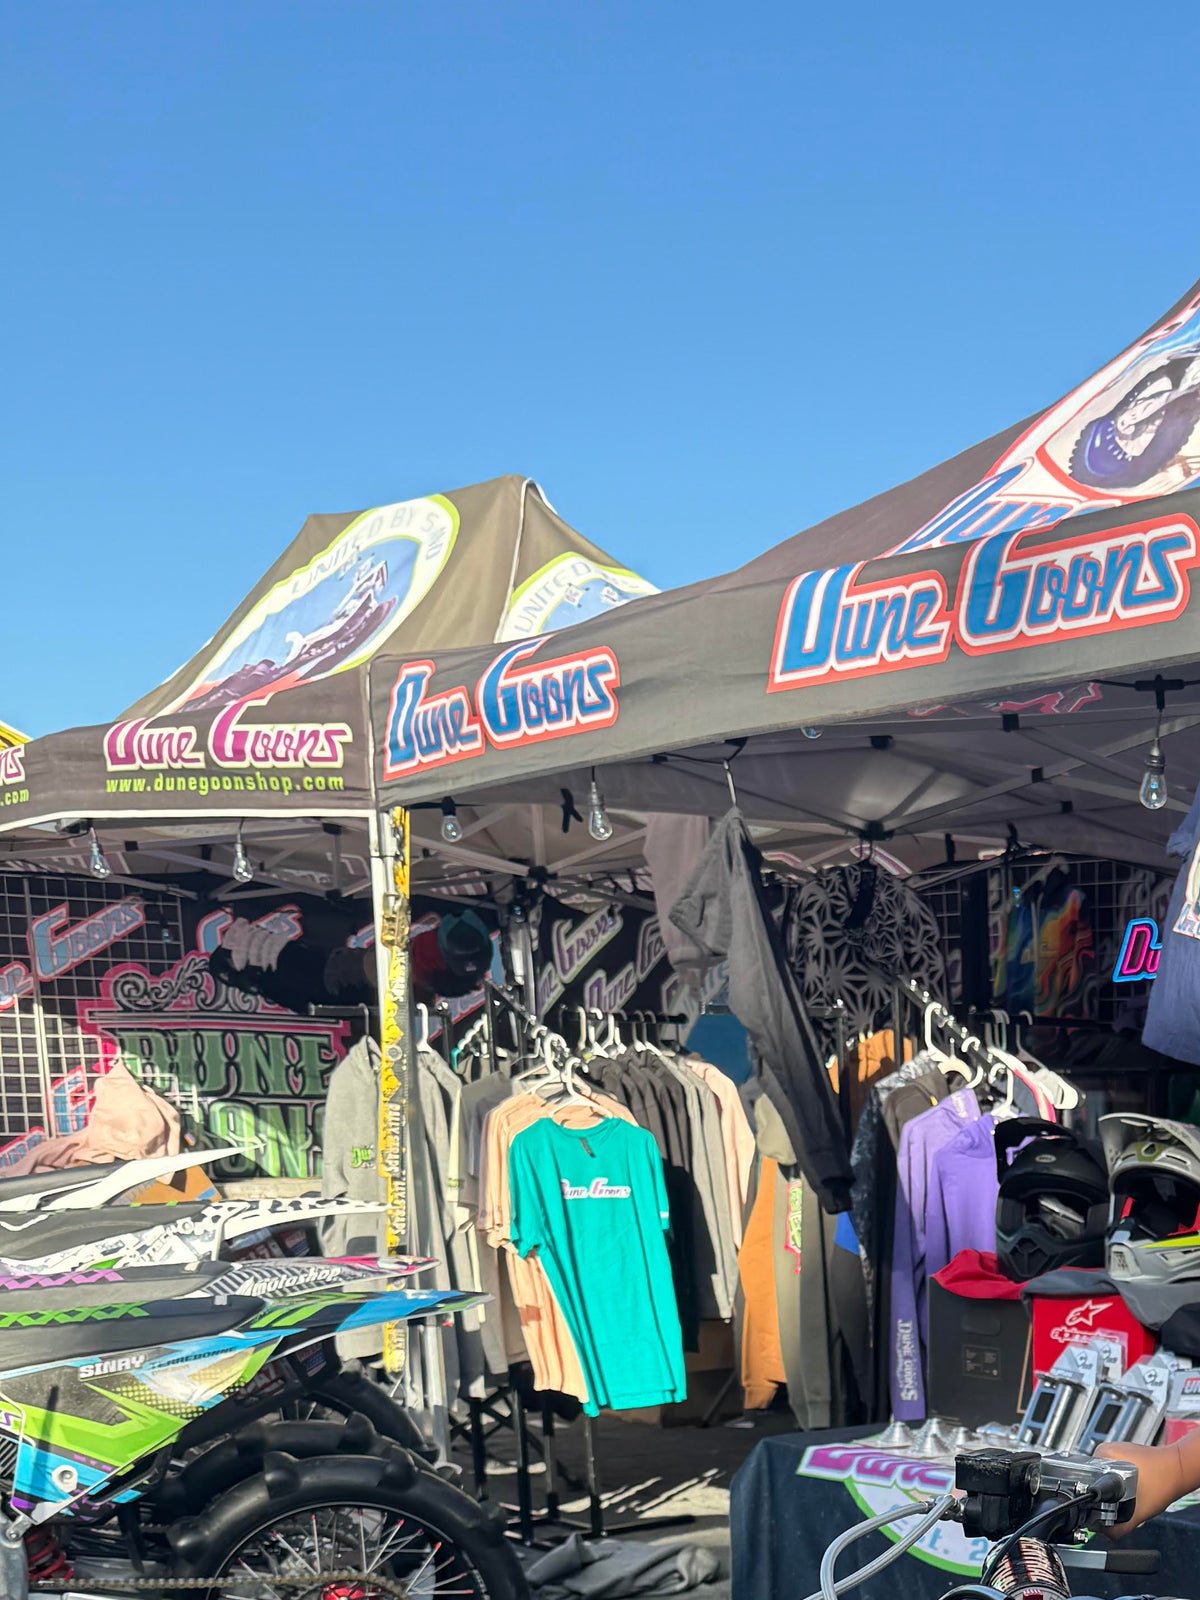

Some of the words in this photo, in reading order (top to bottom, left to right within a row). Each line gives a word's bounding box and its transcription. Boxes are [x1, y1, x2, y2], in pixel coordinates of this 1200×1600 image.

[779, 562, 944, 675] Dune
[963, 528, 1190, 638] Goons
[106, 717, 202, 766] Dune
[212, 701, 348, 763] Goons
[388, 671, 480, 767] Dune
[482, 637, 613, 735] Goons
[105, 772, 345, 796] www.dunegoonshop.com
